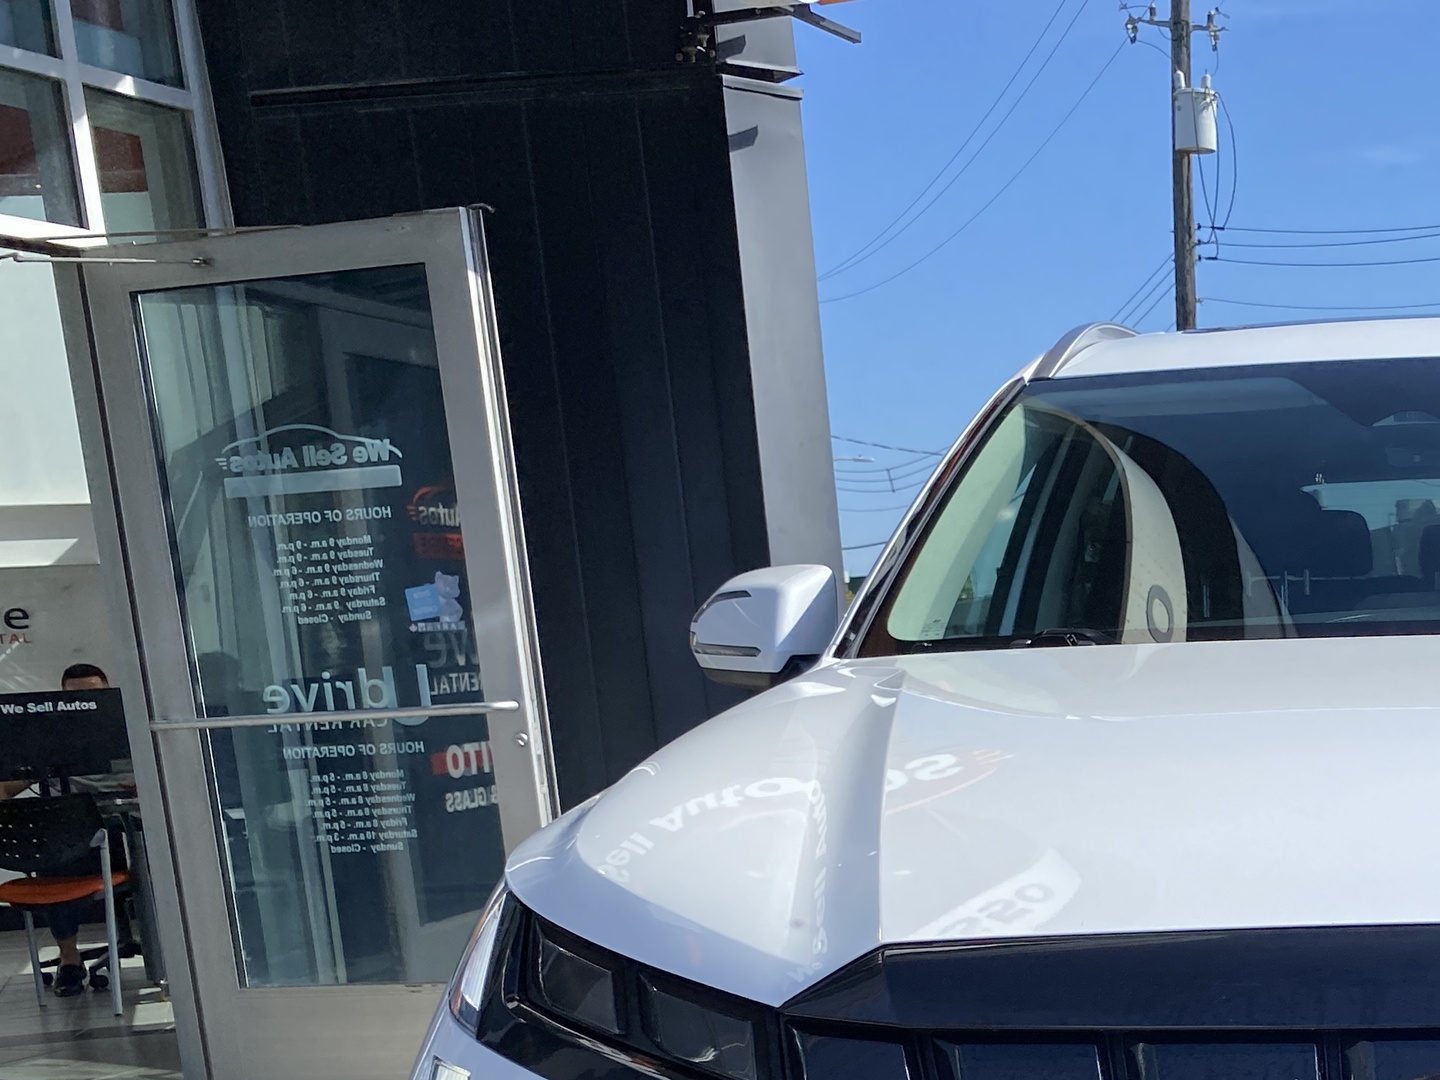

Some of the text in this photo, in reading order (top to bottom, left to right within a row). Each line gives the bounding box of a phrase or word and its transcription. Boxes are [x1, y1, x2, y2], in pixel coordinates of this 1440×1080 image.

[0, 701, 97, 714] We Sell Autos
